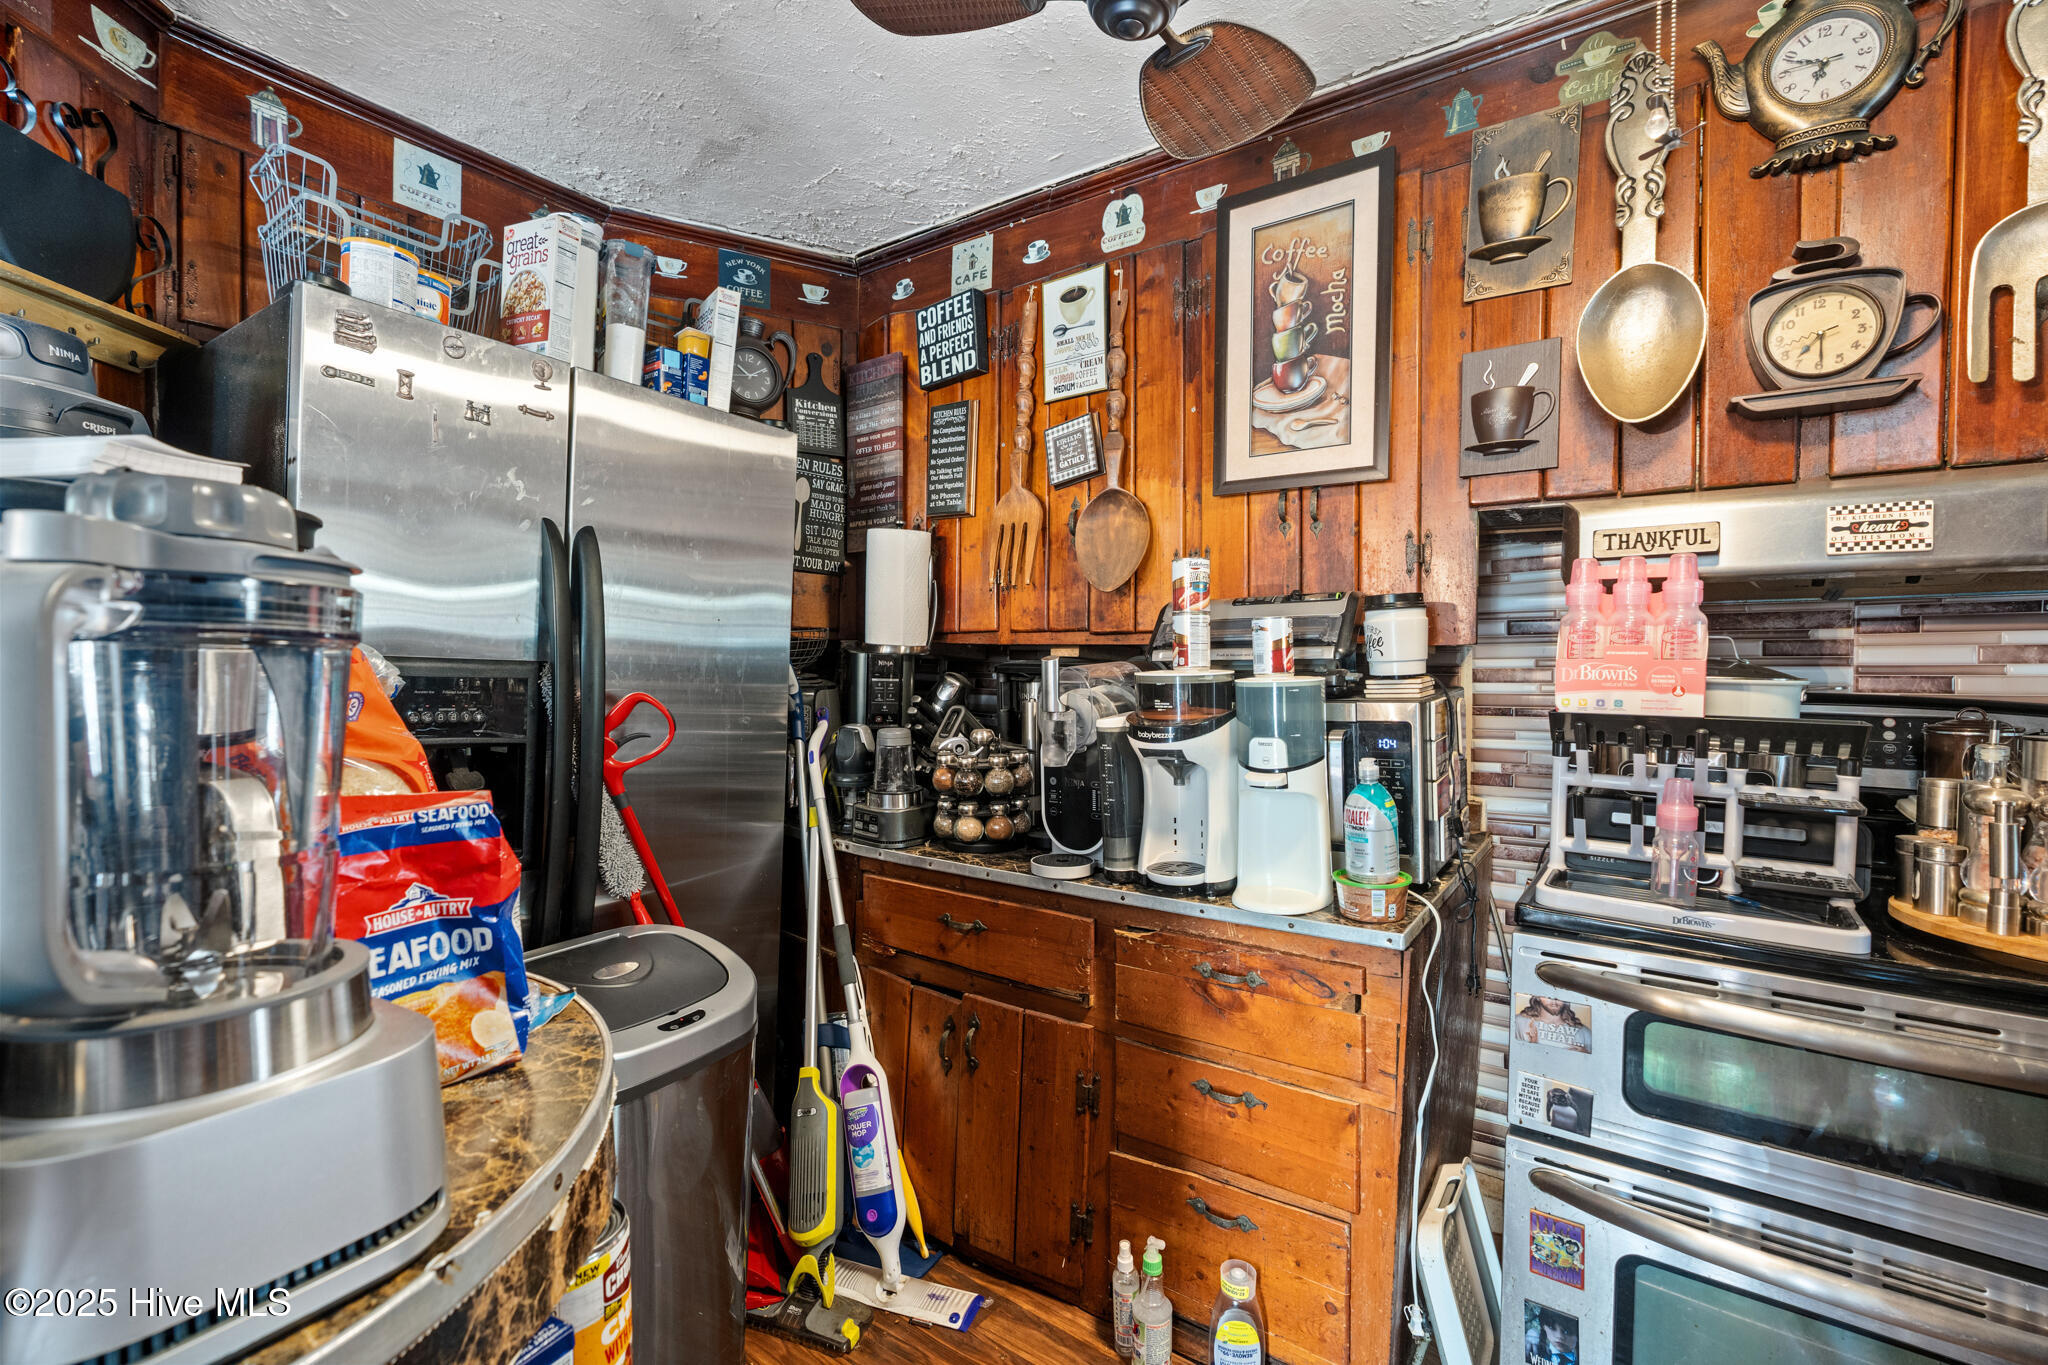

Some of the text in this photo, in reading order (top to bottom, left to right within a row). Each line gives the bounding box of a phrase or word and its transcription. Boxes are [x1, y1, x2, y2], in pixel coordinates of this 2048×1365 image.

[1817, 25, 1833, 38] 12
[1840, 25, 1849, 37] 1
[1852, 31, 1868, 43] 2
[1798, 35, 1813, 48] 11
[1857, 46, 1873, 56] 3
[1783, 83, 1797, 94] 8
[1840, 78, 1852, 90] 5
[1800, 89, 1810, 101] 7
[1820, 88, 1829, 101] 6
[400, 184, 443, 205] COFFEE
[1102, 231, 1134, 245] COFFEE
[506, 231, 539, 264] great
[1262, 236, 1329, 271] Coffee
[509, 248, 549, 275] grains
[725, 258, 766, 275] NEW YORK
[955, 265, 988, 286] CAFÉ
[1320, 267, 1348, 335] Mocha
[1813, 299, 1826, 310] 12
[1838, 300, 1844, 310] 1
[918, 292, 973, 331] COFFEE
[1795, 306, 1806, 317] 11
[1852, 308, 1860, 320] 2
[506, 316, 525, 325] CRUNCHY
[1781, 320, 1796, 331] 10
[919, 314, 974, 348] AND FRIENDS
[1858, 323, 1867, 334] 3
[921, 331, 974, 365] A PERFECT
[1056, 338, 1075, 348] SMALL
[1851, 339, 1861, 350] 4
[48, 344, 81, 363] NINJA
[746, 353, 754, 363] 12
[1781, 350, 1790, 361] 8
[1835, 353, 1844, 364] 5
[921, 350, 977, 386] BLEND
[1080, 356, 1104, 369] CREAM
[764, 376, 770, 385] 3
[1053, 367, 1098, 385] SUGAR COFFEE
[1053, 382, 1076, 395] MEDIUM
[744, 391, 751, 399] 6
[795, 398, 837, 412] Kitchen
[794, 407, 838, 418] Conversions
[933, 407, 967, 419] KITCHEN RULES
[940, 426, 966, 435] Complaining
[939, 435, 966, 444] Substitutions
[856, 446, 872, 455] OFFER
[882, 441, 896, 450] HELP
[948, 445, 965, 453] Arrivals
[937, 457, 951, 465] Special
[1059, 454, 1085, 469] GATHER
[813, 460, 843, 476] RULES
[936, 468, 952, 476] Talking
[812, 478, 847, 494] SAY GRACE
[882, 480, 896, 490] your
[944, 482, 964, 490] Vegetables
[876, 490, 895, 500] closed
[810, 499, 831, 510] MAD
[834, 503, 846, 514] OR
[809, 508, 846, 523] HUNGRY
[887, 515, 896, 523] LAP
[1852, 513, 1894, 521] KITCHEN
[1859, 520, 1901, 533] heart
[805, 525, 844, 541] SIT LONG
[807, 536, 839, 547] TALK MUCH
[1602, 527, 1712, 553] THANKFUL
[806, 545, 840, 557] LAUGH OFTEN
[802, 556, 823, 570] YOUR
[824, 560, 841, 573] DAY
[1579, 664, 1638, 682] Brown's
[418, 803, 490, 824] SEAFOOD
[421, 818, 487, 834] SEASONED FRYING MIX
[1590, 856, 1615, 864] SIZZLE
[368, 927, 494, 979] EAFOOD
[371, 956, 480, 999] EASONED FRYING MIX
[1546, 1023, 1579, 1036] SAW
[1524, 1077, 1539, 1085] YOUR
[1521, 1083, 1541, 1092] SECRET
[1527, 1089, 1540, 1097] SAFE
[1518, 1093, 1532, 1101] WITH
[1519, 1098, 1541, 1109] BECAUSE
[1529, 1106, 1540, 1114] NOT
[848, 1120, 872, 1131] POWER
[575, 1263, 600, 1280] NEW
